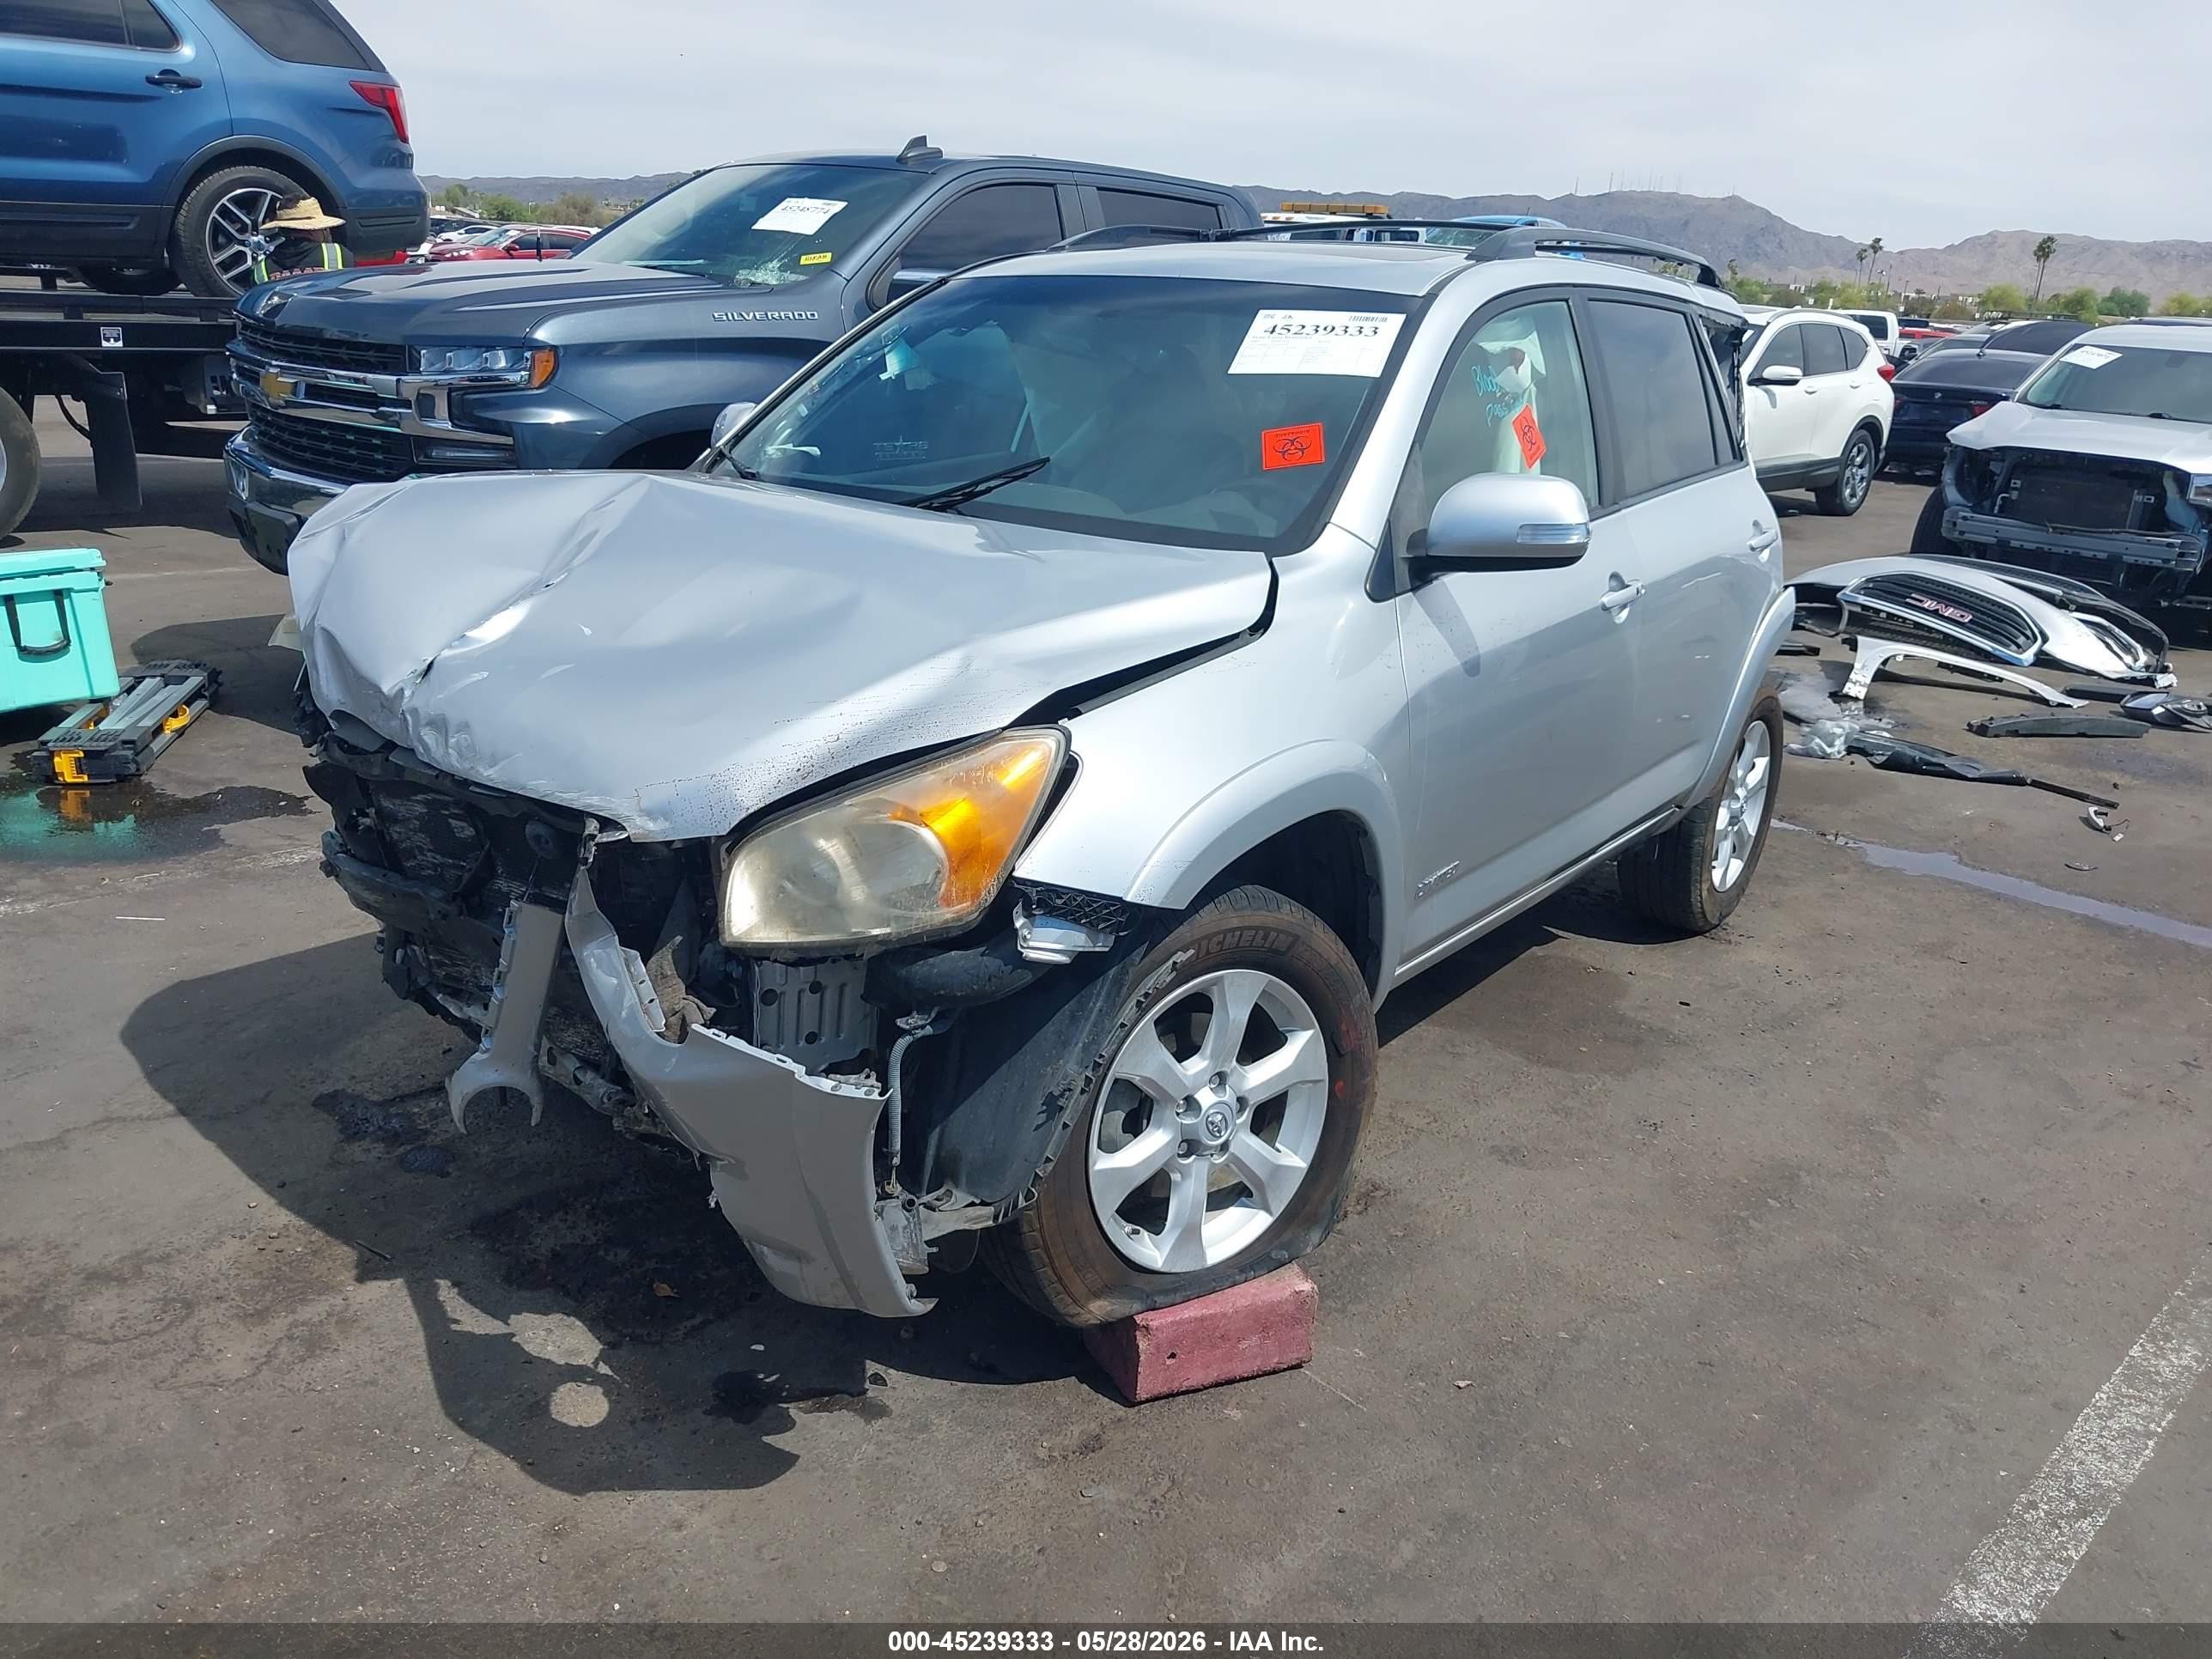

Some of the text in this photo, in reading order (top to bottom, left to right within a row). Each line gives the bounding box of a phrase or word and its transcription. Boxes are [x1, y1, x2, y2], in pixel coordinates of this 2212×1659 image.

[712, 310, 818, 322] SILVERADO
[1263, 324, 1380, 337] 45239333
[1905, 592, 1973, 623] GMC
